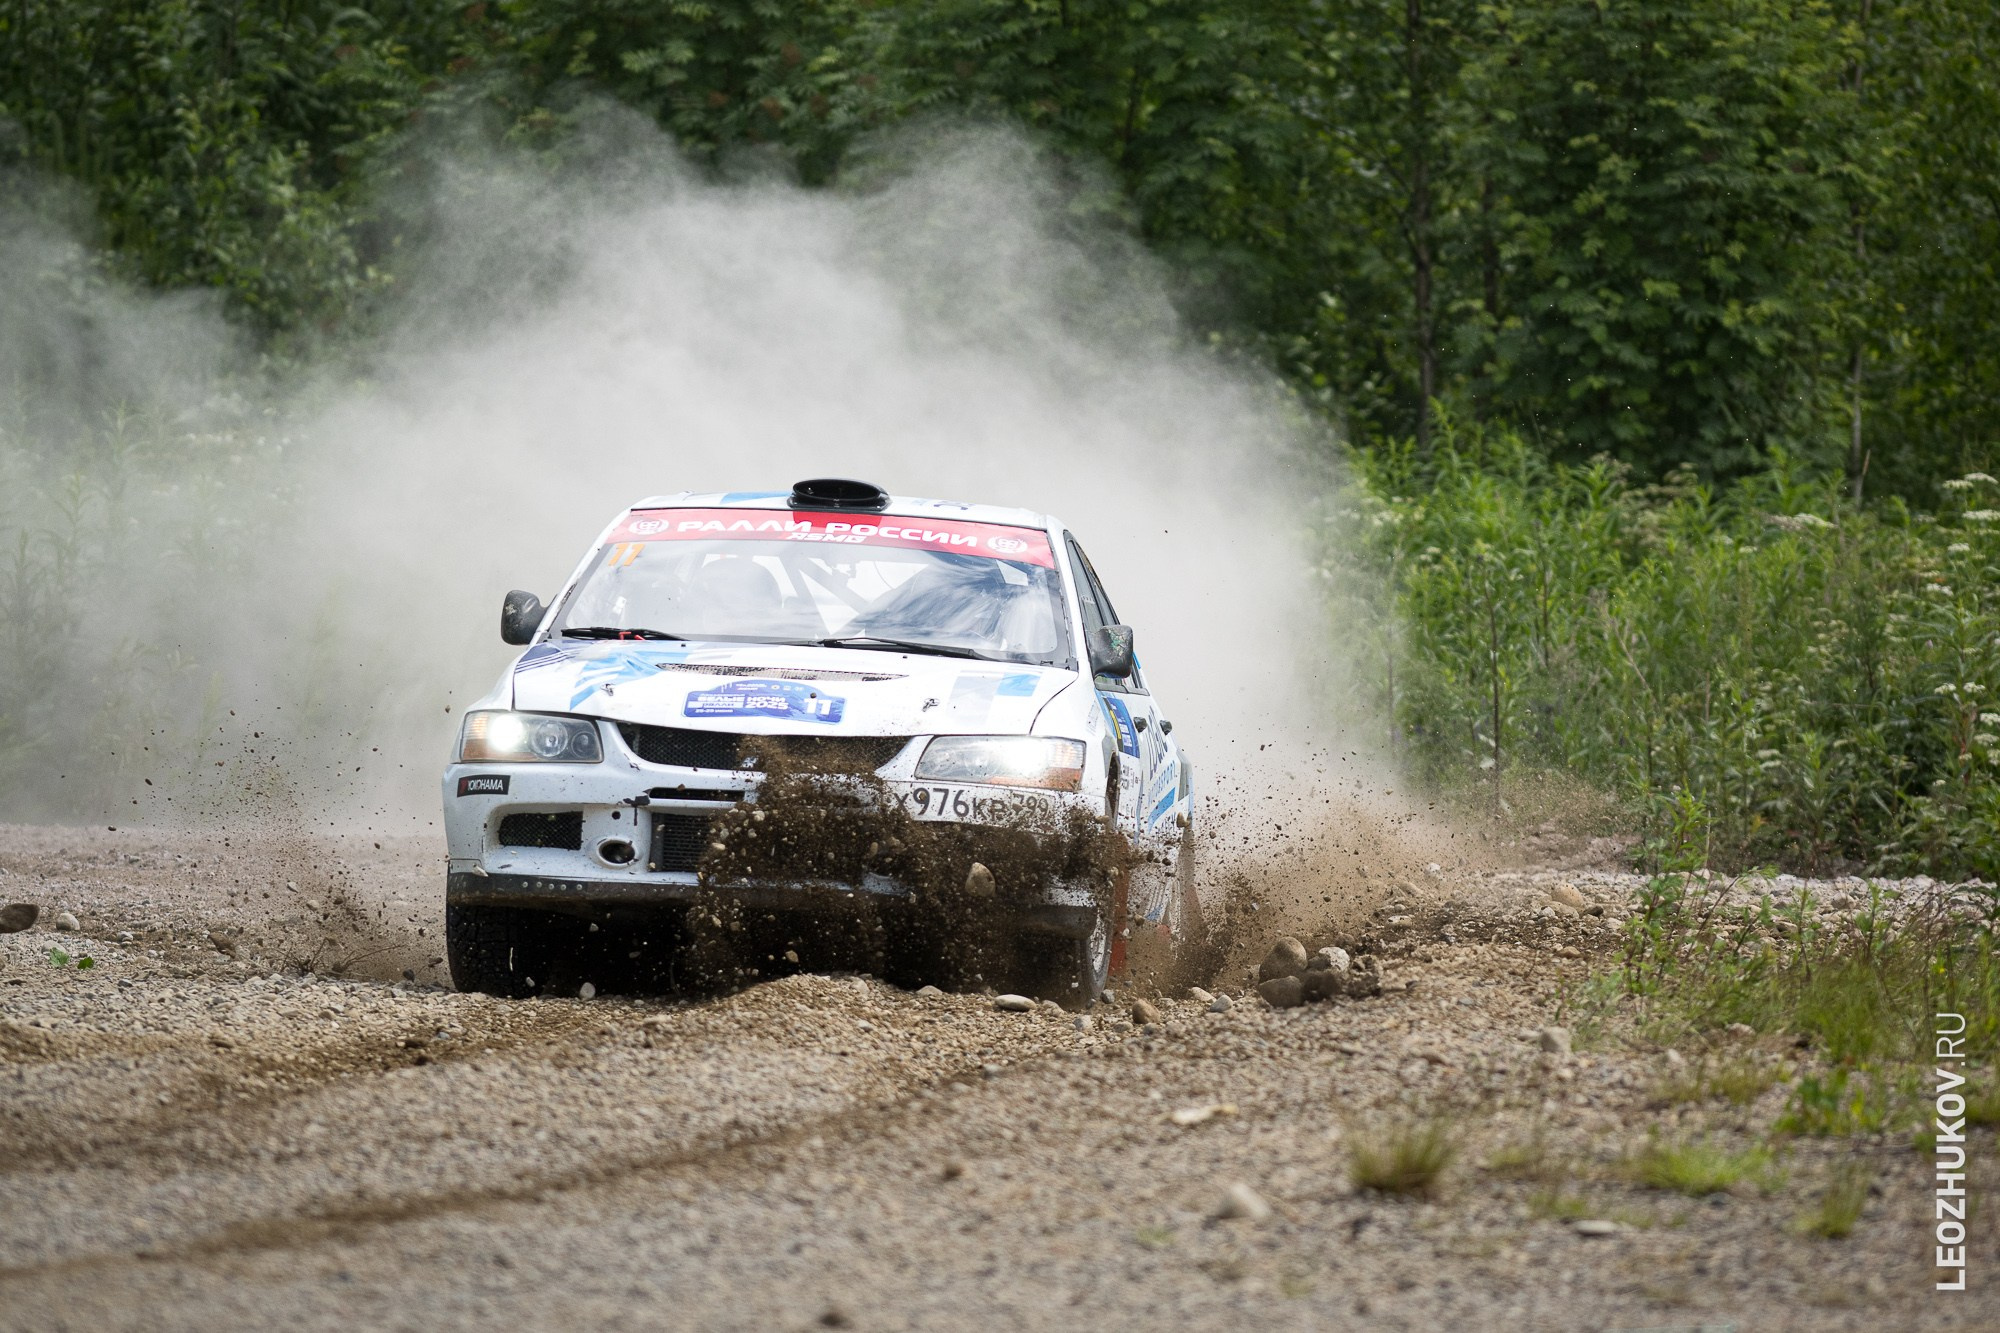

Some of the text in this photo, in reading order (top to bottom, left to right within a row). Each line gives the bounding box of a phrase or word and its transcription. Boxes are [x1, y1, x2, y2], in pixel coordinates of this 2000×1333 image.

[677, 520, 977, 547] РАЛЛИ РОССИИ
[608, 543, 645, 566] 11
[745, 701, 789, 710] 2025
[804, 698, 832, 715] 11
[468, 779, 503, 791] YOKOHAMA
